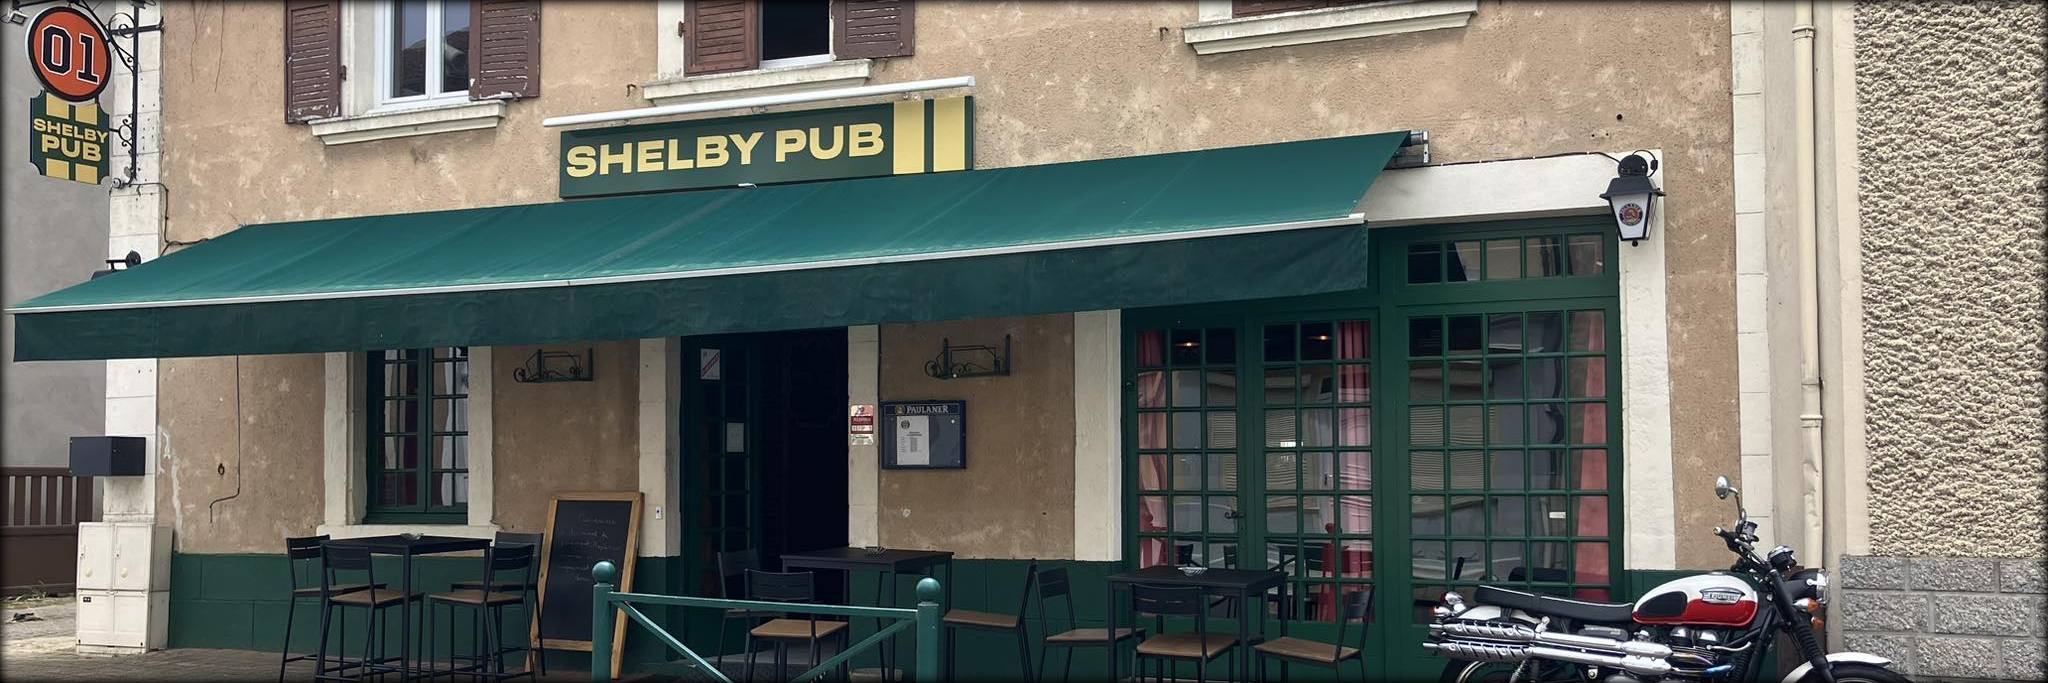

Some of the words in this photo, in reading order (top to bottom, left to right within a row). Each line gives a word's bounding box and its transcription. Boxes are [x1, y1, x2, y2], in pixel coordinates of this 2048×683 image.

[41, 24, 100, 85] 01
[33, 118, 109, 144] SHELBY
[41, 134, 102, 163] PUB
[566, 131, 764, 178] SHELBY
[775, 122, 885, 163] PUB
[906, 405, 949, 414] PAULANER
